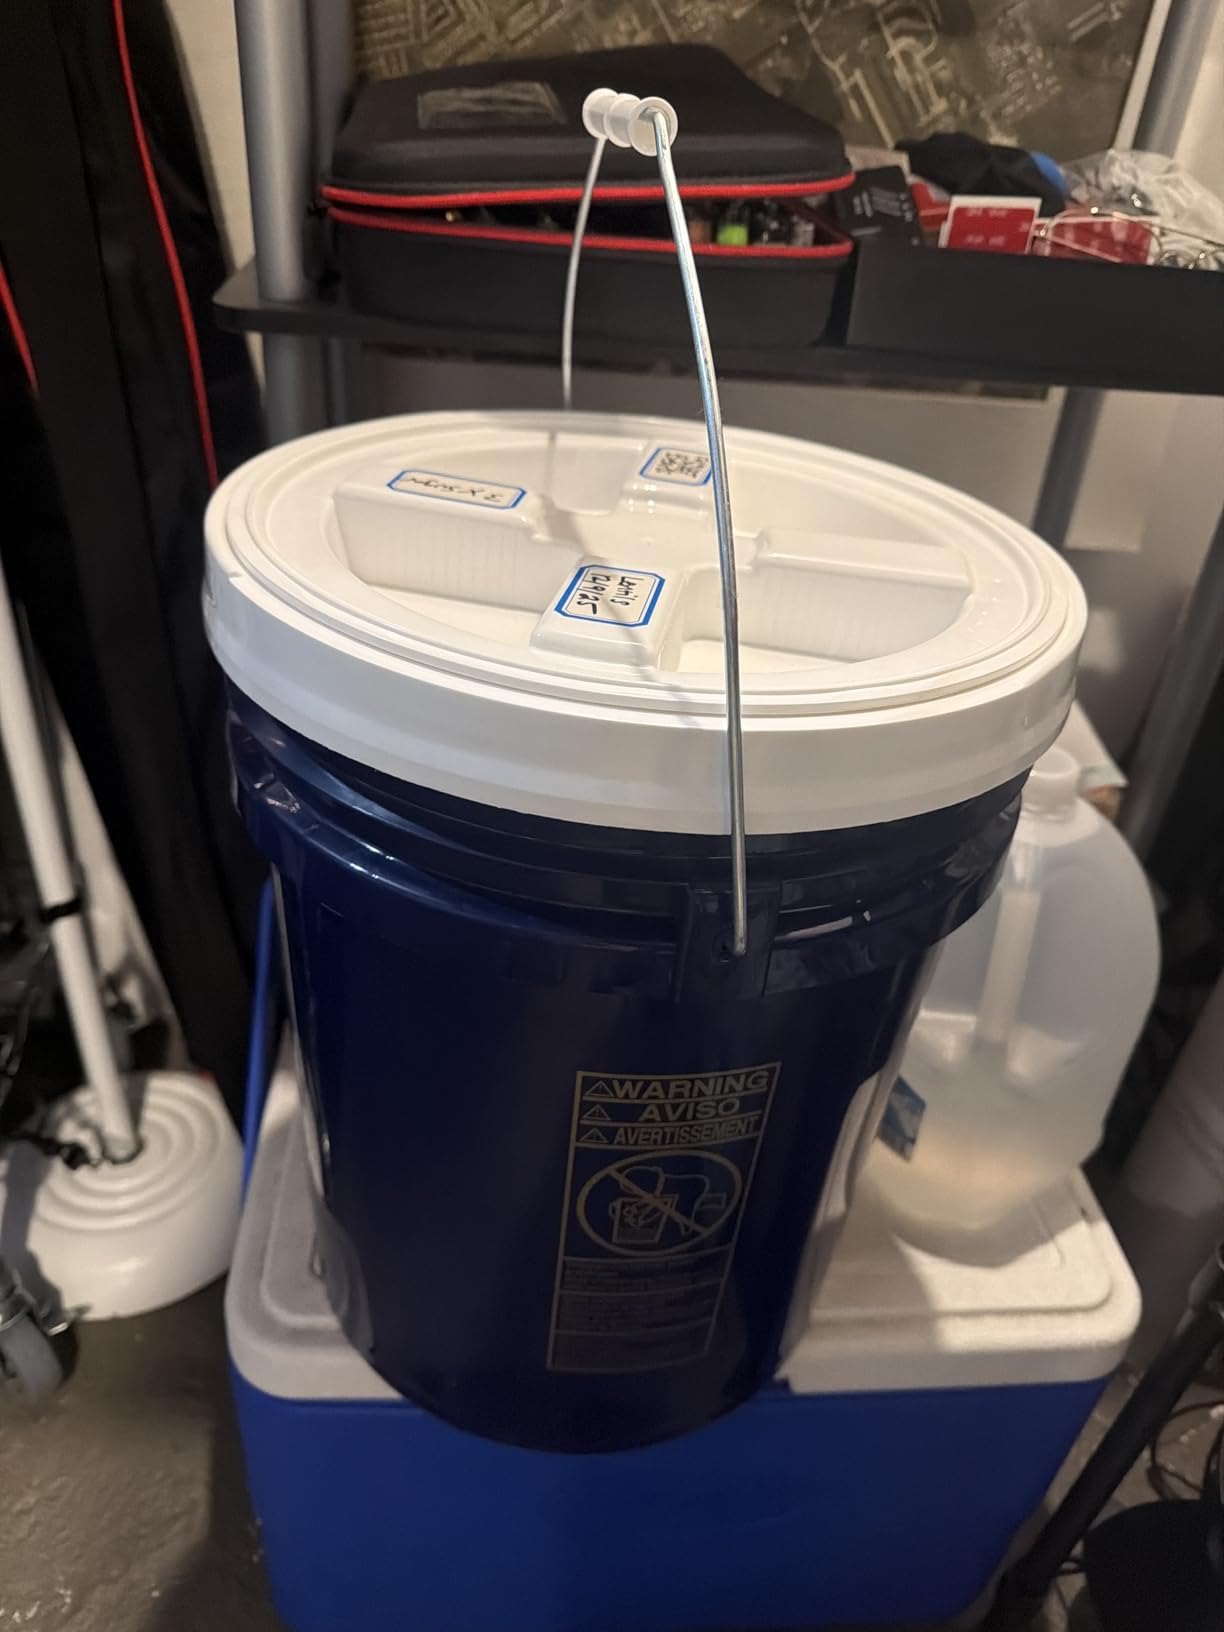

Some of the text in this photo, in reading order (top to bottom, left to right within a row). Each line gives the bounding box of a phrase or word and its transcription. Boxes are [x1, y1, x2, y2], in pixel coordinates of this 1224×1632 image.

[612, 1070, 769, 1099] WARNING
[638, 1098, 740, 1122] AVISO
[613, 1115, 760, 1145] AVERTISSEMENT
